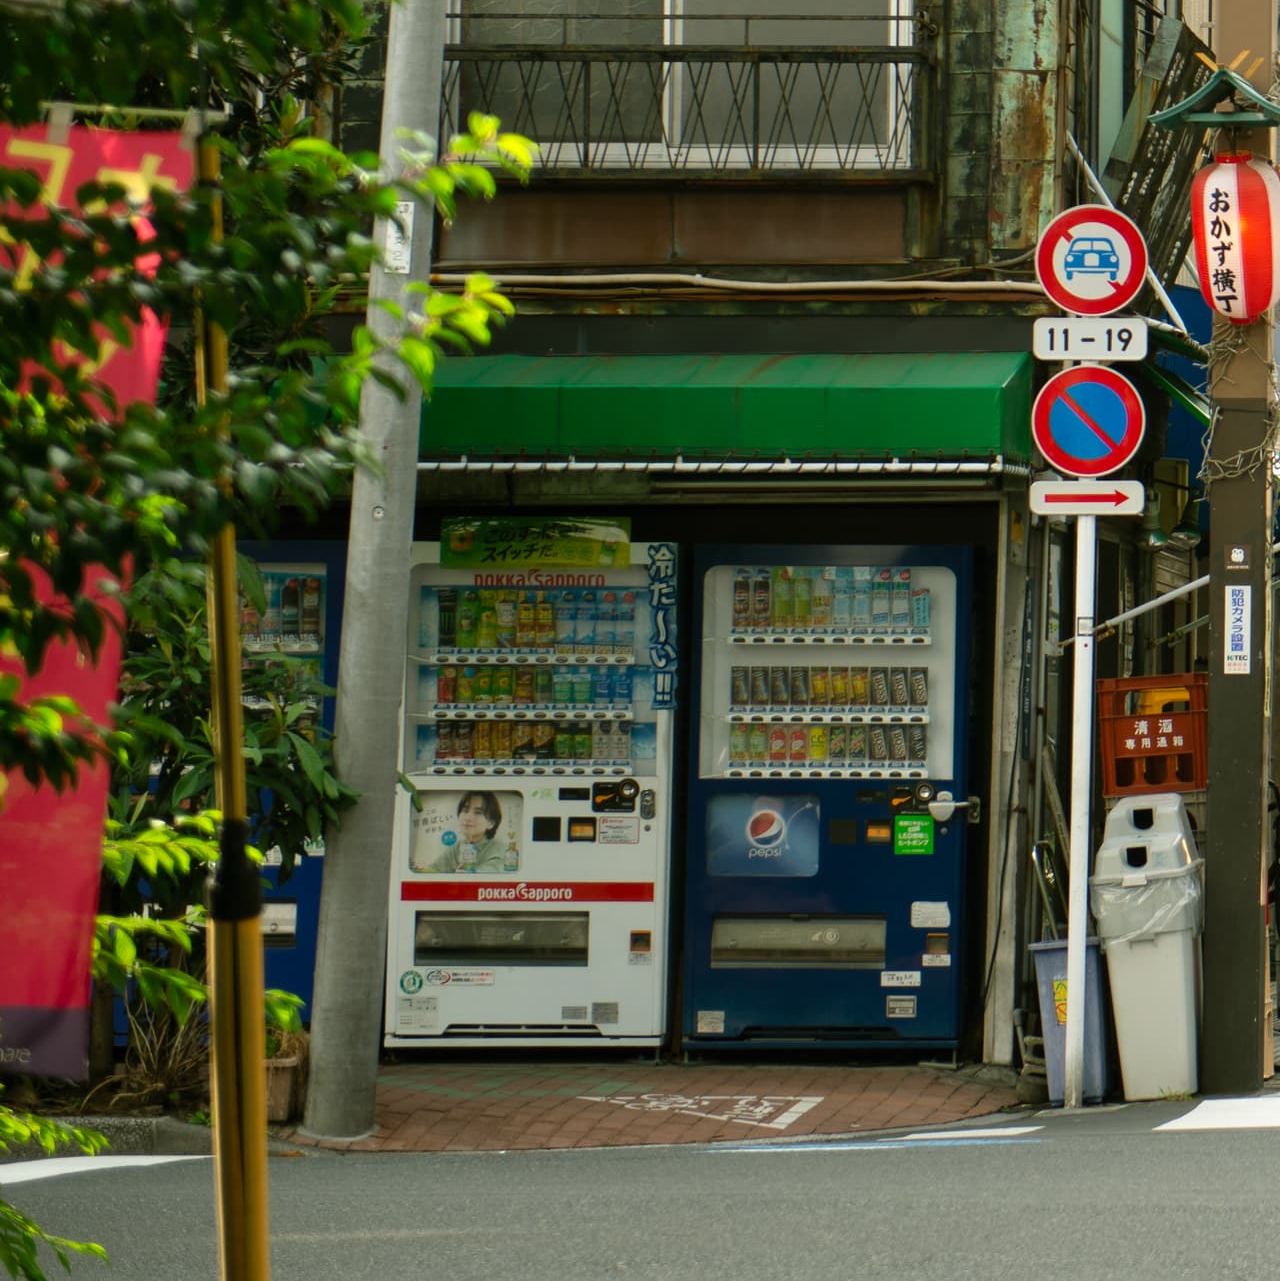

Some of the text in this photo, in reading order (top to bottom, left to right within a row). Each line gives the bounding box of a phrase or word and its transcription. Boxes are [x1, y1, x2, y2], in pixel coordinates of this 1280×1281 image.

[1207, 186, 1240, 314] おかず横丁
[1047, 327, 1133, 352] 11-19
[1231, 589, 1245, 652] 防犯カメラ設置
[1134, 719, 1173, 735] 清酒
[748, 846, 782, 860] pepsi
